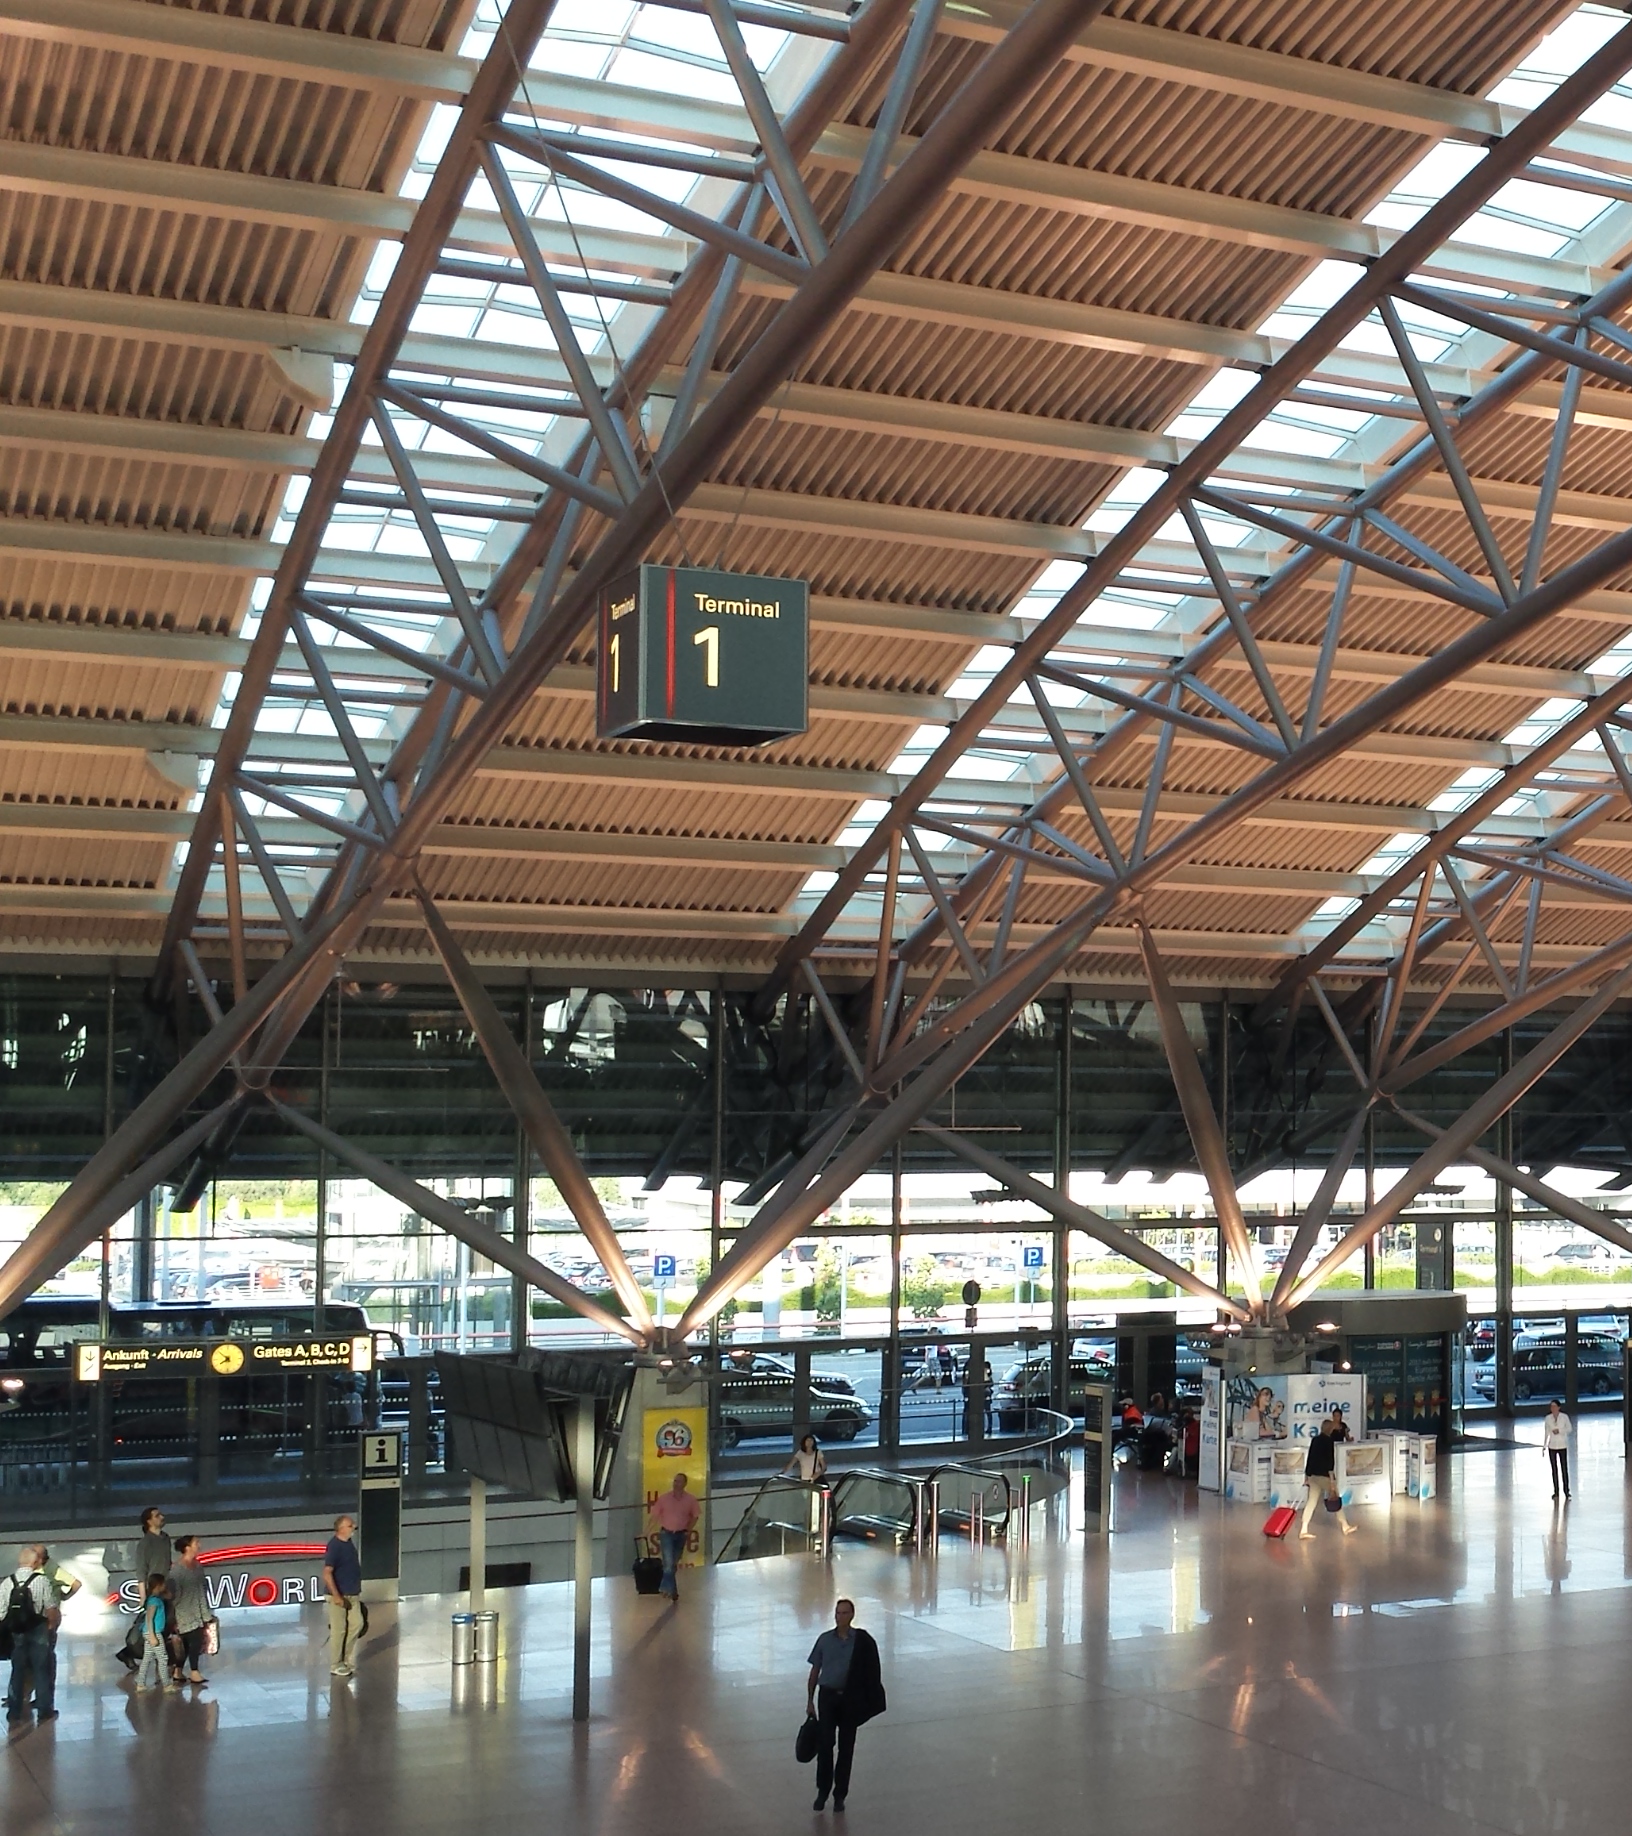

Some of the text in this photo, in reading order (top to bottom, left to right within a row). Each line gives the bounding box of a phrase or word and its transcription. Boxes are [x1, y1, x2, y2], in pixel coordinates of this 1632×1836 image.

[611, 593, 636, 621] Terminal
[693, 593, 780, 619] Terminal
[610, 633, 620, 693] 1
[693, 626, 720, 688] 1
[1027, 1248, 1040, 1265] P
[658, 1257, 672, 1274] P
[103, 1348, 203, 1361] Ankunft Arrivals
[253, 1345, 292, 1359] Gates
[1293, 1398, 1351, 1414] meine
